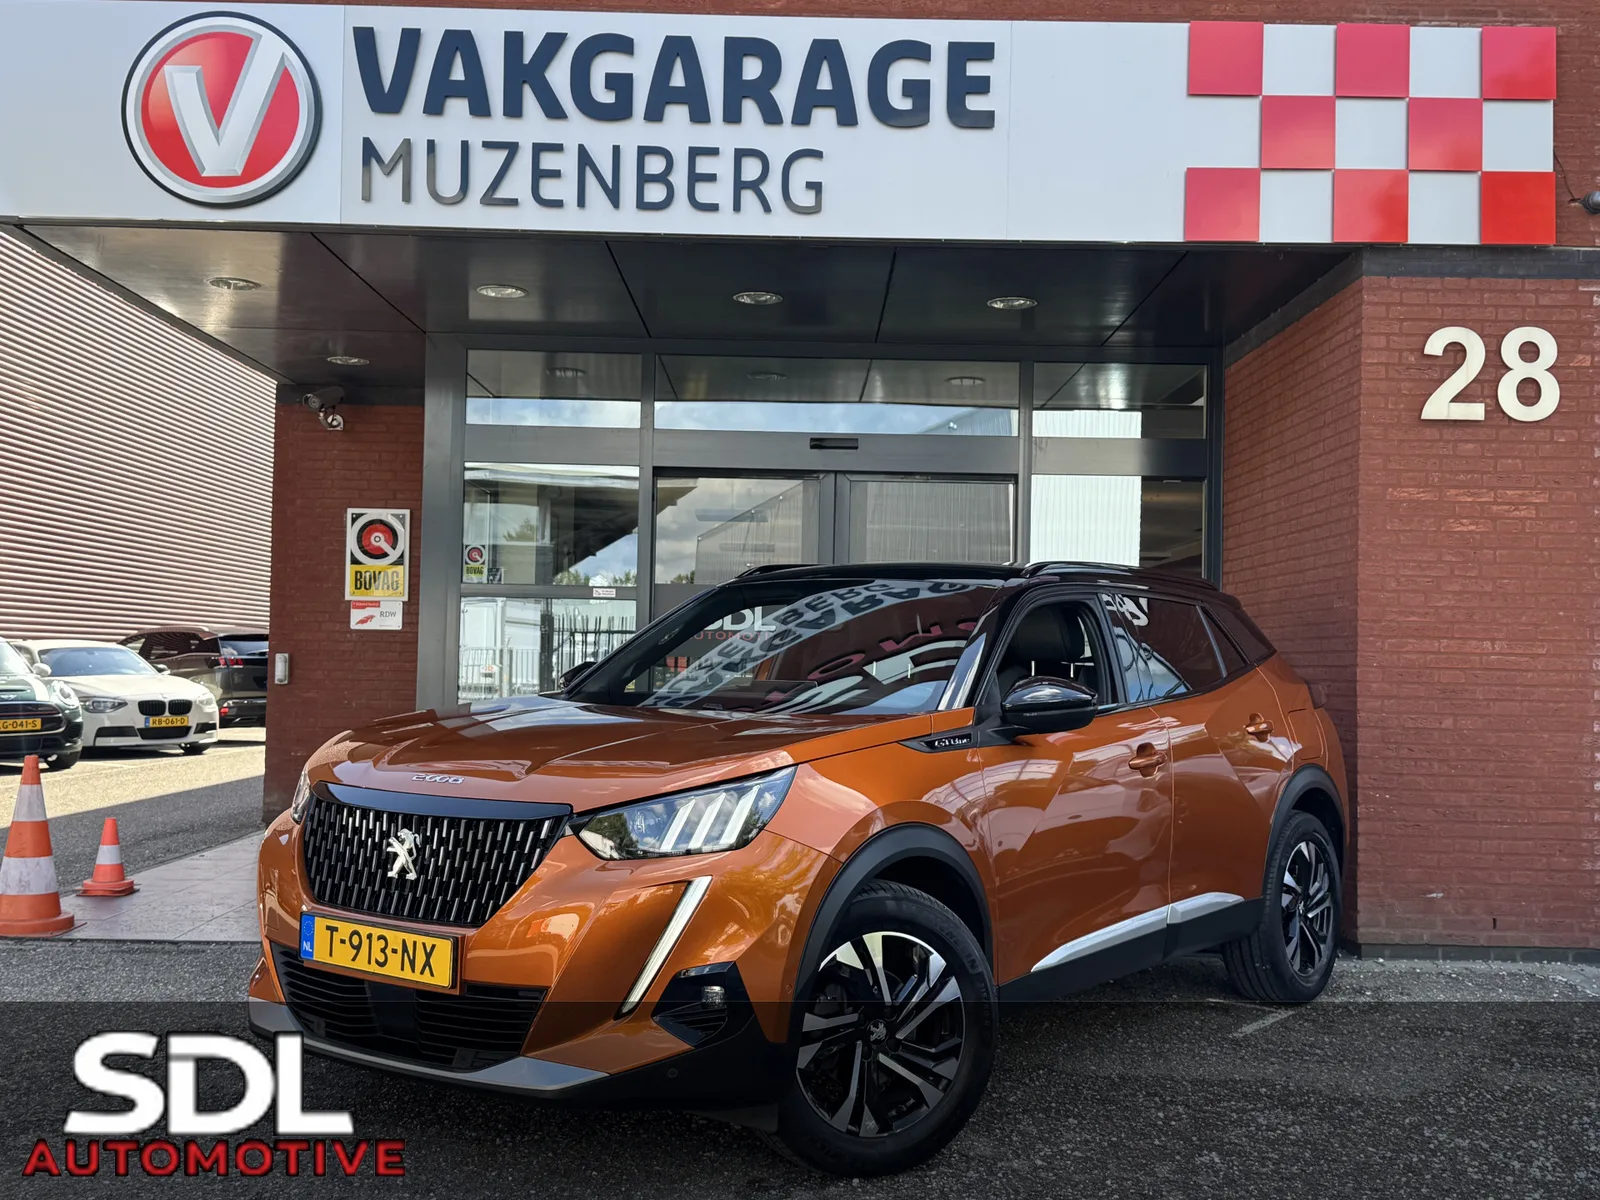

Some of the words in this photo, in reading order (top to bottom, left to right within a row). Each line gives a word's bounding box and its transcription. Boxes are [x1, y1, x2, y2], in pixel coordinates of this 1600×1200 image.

[352, 26, 995, 128] VAKGARAGE
[361, 136, 824, 214] MUZENBERG
[1421, 326, 1560, 422] 28
[354, 569, 400, 592] BOVAG
[379, 610, 397, 619] RDW
[0, 719, 37, 730] G-041-S
[152, 717, 186, 726] RB-061-D
[411, 773, 465, 784] 2008
[303, 941, 312, 952] NL
[325, 925, 436, 977] T-913-NX
